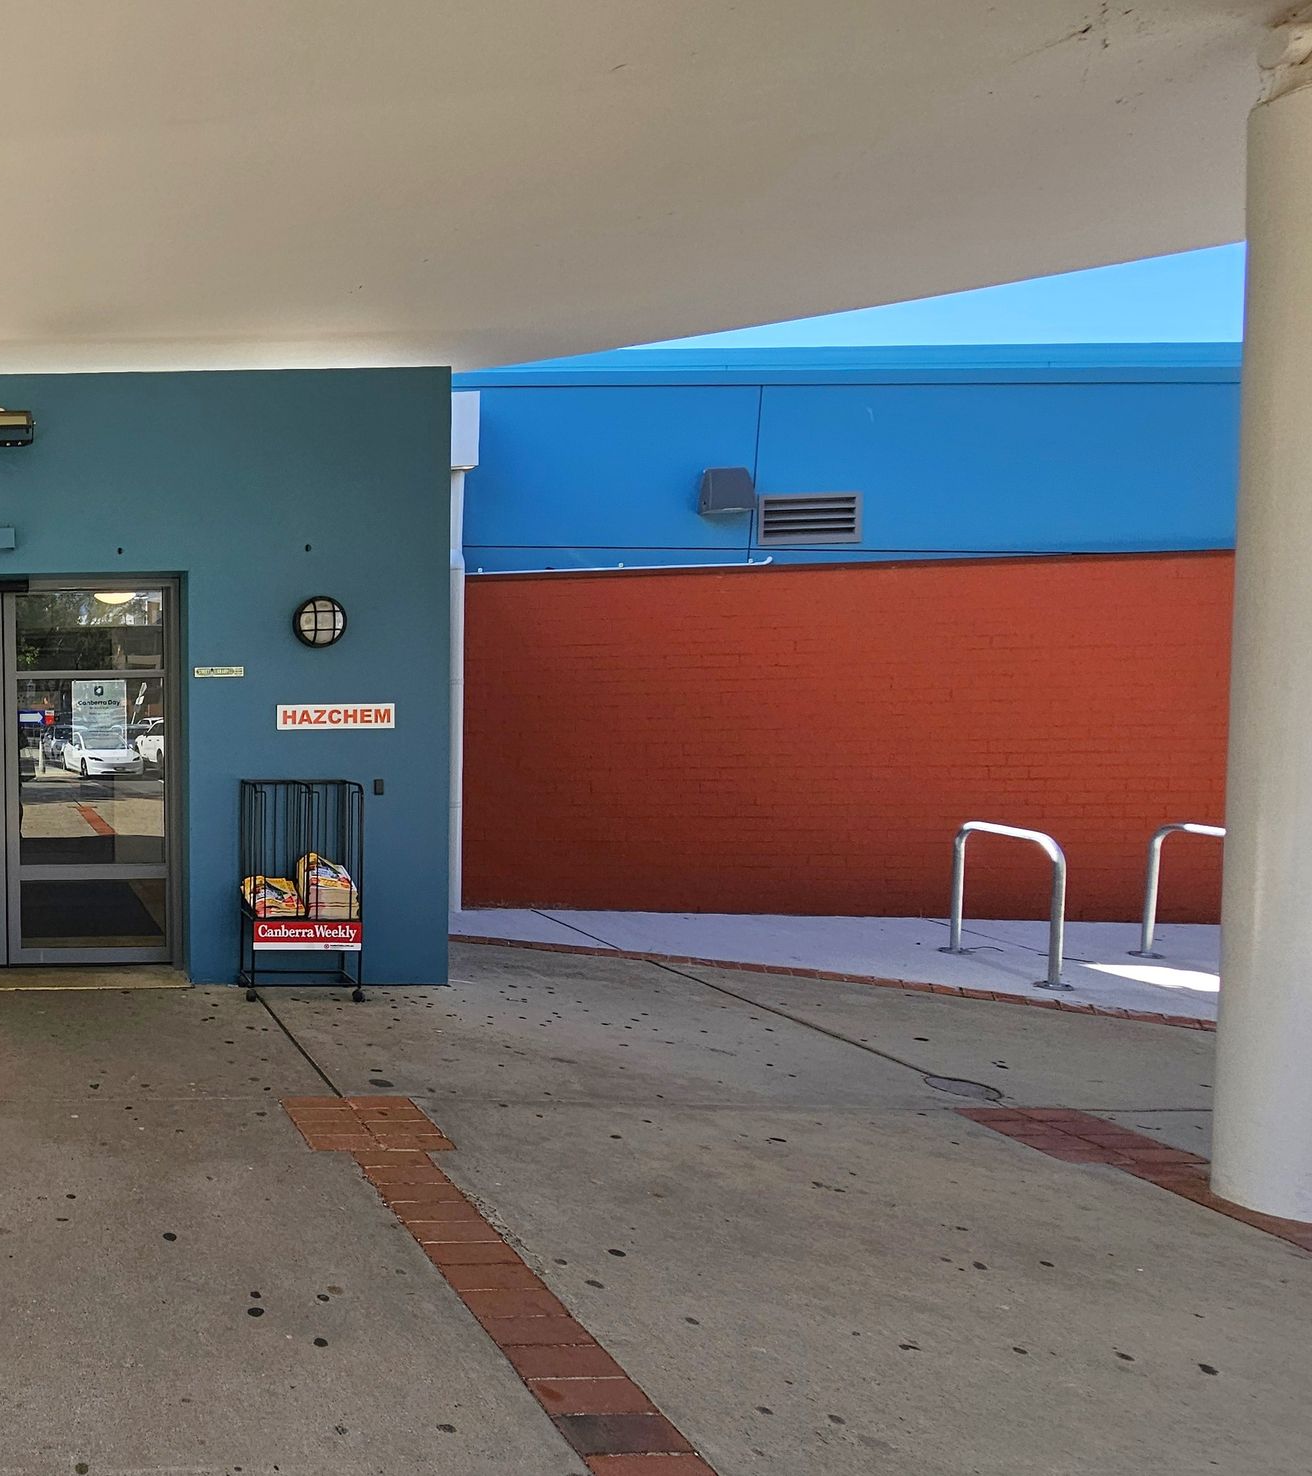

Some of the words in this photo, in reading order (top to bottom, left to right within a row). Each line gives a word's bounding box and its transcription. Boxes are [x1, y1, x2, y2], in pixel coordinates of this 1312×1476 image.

[282, 708, 391, 725] HAZCHEM
[258, 924, 314, 938] Canberra
[314, 924, 357, 942] Weekly
